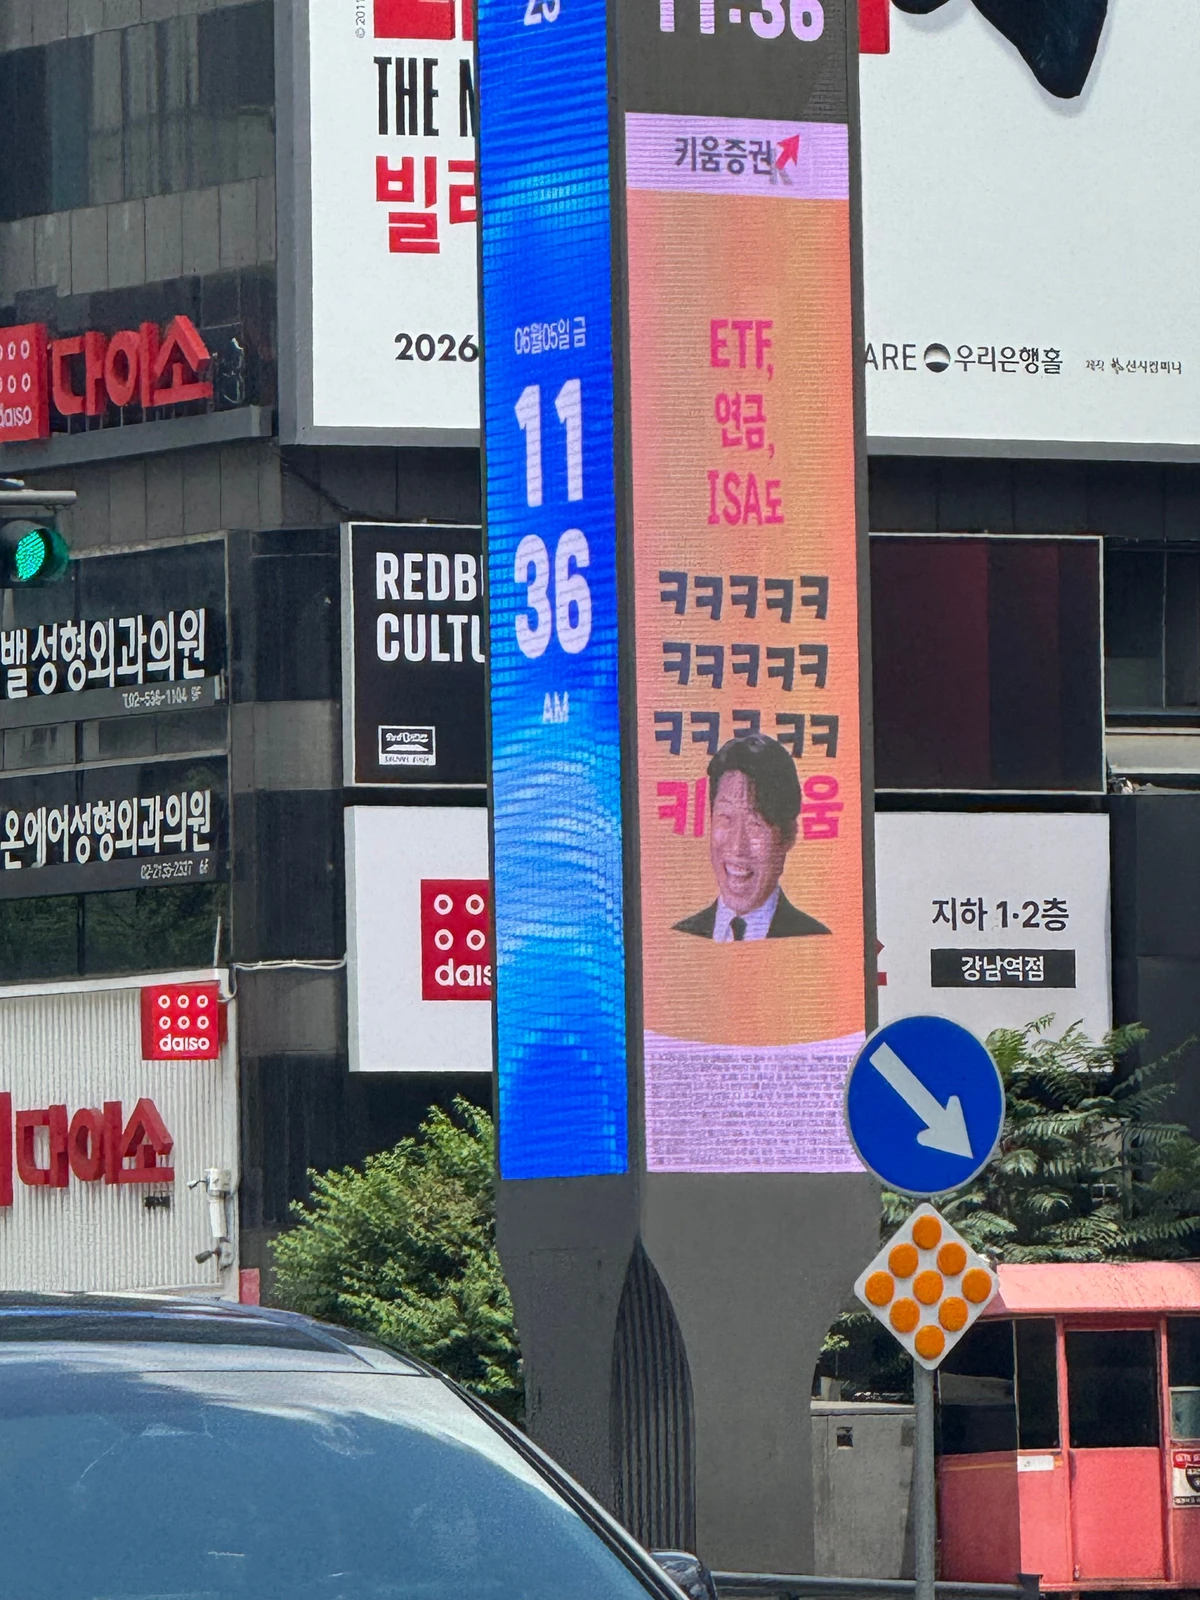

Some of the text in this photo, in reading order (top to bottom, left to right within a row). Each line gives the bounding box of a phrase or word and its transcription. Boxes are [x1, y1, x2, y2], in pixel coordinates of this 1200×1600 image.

[373, 56, 439, 137] THE
[674, 135, 773, 176] 키움증권
[395, 333, 479, 362] 2026
[573, 316, 587, 348] 금
[710, 319, 774, 381] ETF,
[52, 314, 214, 416] 다이소
[953, 344, 1063, 375] 우리은행홀
[514, 378, 584, 508] 11
[714, 391, 775, 459] 연금,
[707, 470, 785, 526] ISA도
[376, 552, 485, 602] REDB
[514, 528, 592, 659] 36
[541, 691, 569, 724] AM
[0, 789, 212, 870] 온에어성형외과의원
[932, 896, 988, 932] 지하
[961, 955, 1045, 982] 강남역점
[159, 1033, 210, 1052] daiso
[16, 1096, 175, 1188] 다이소
